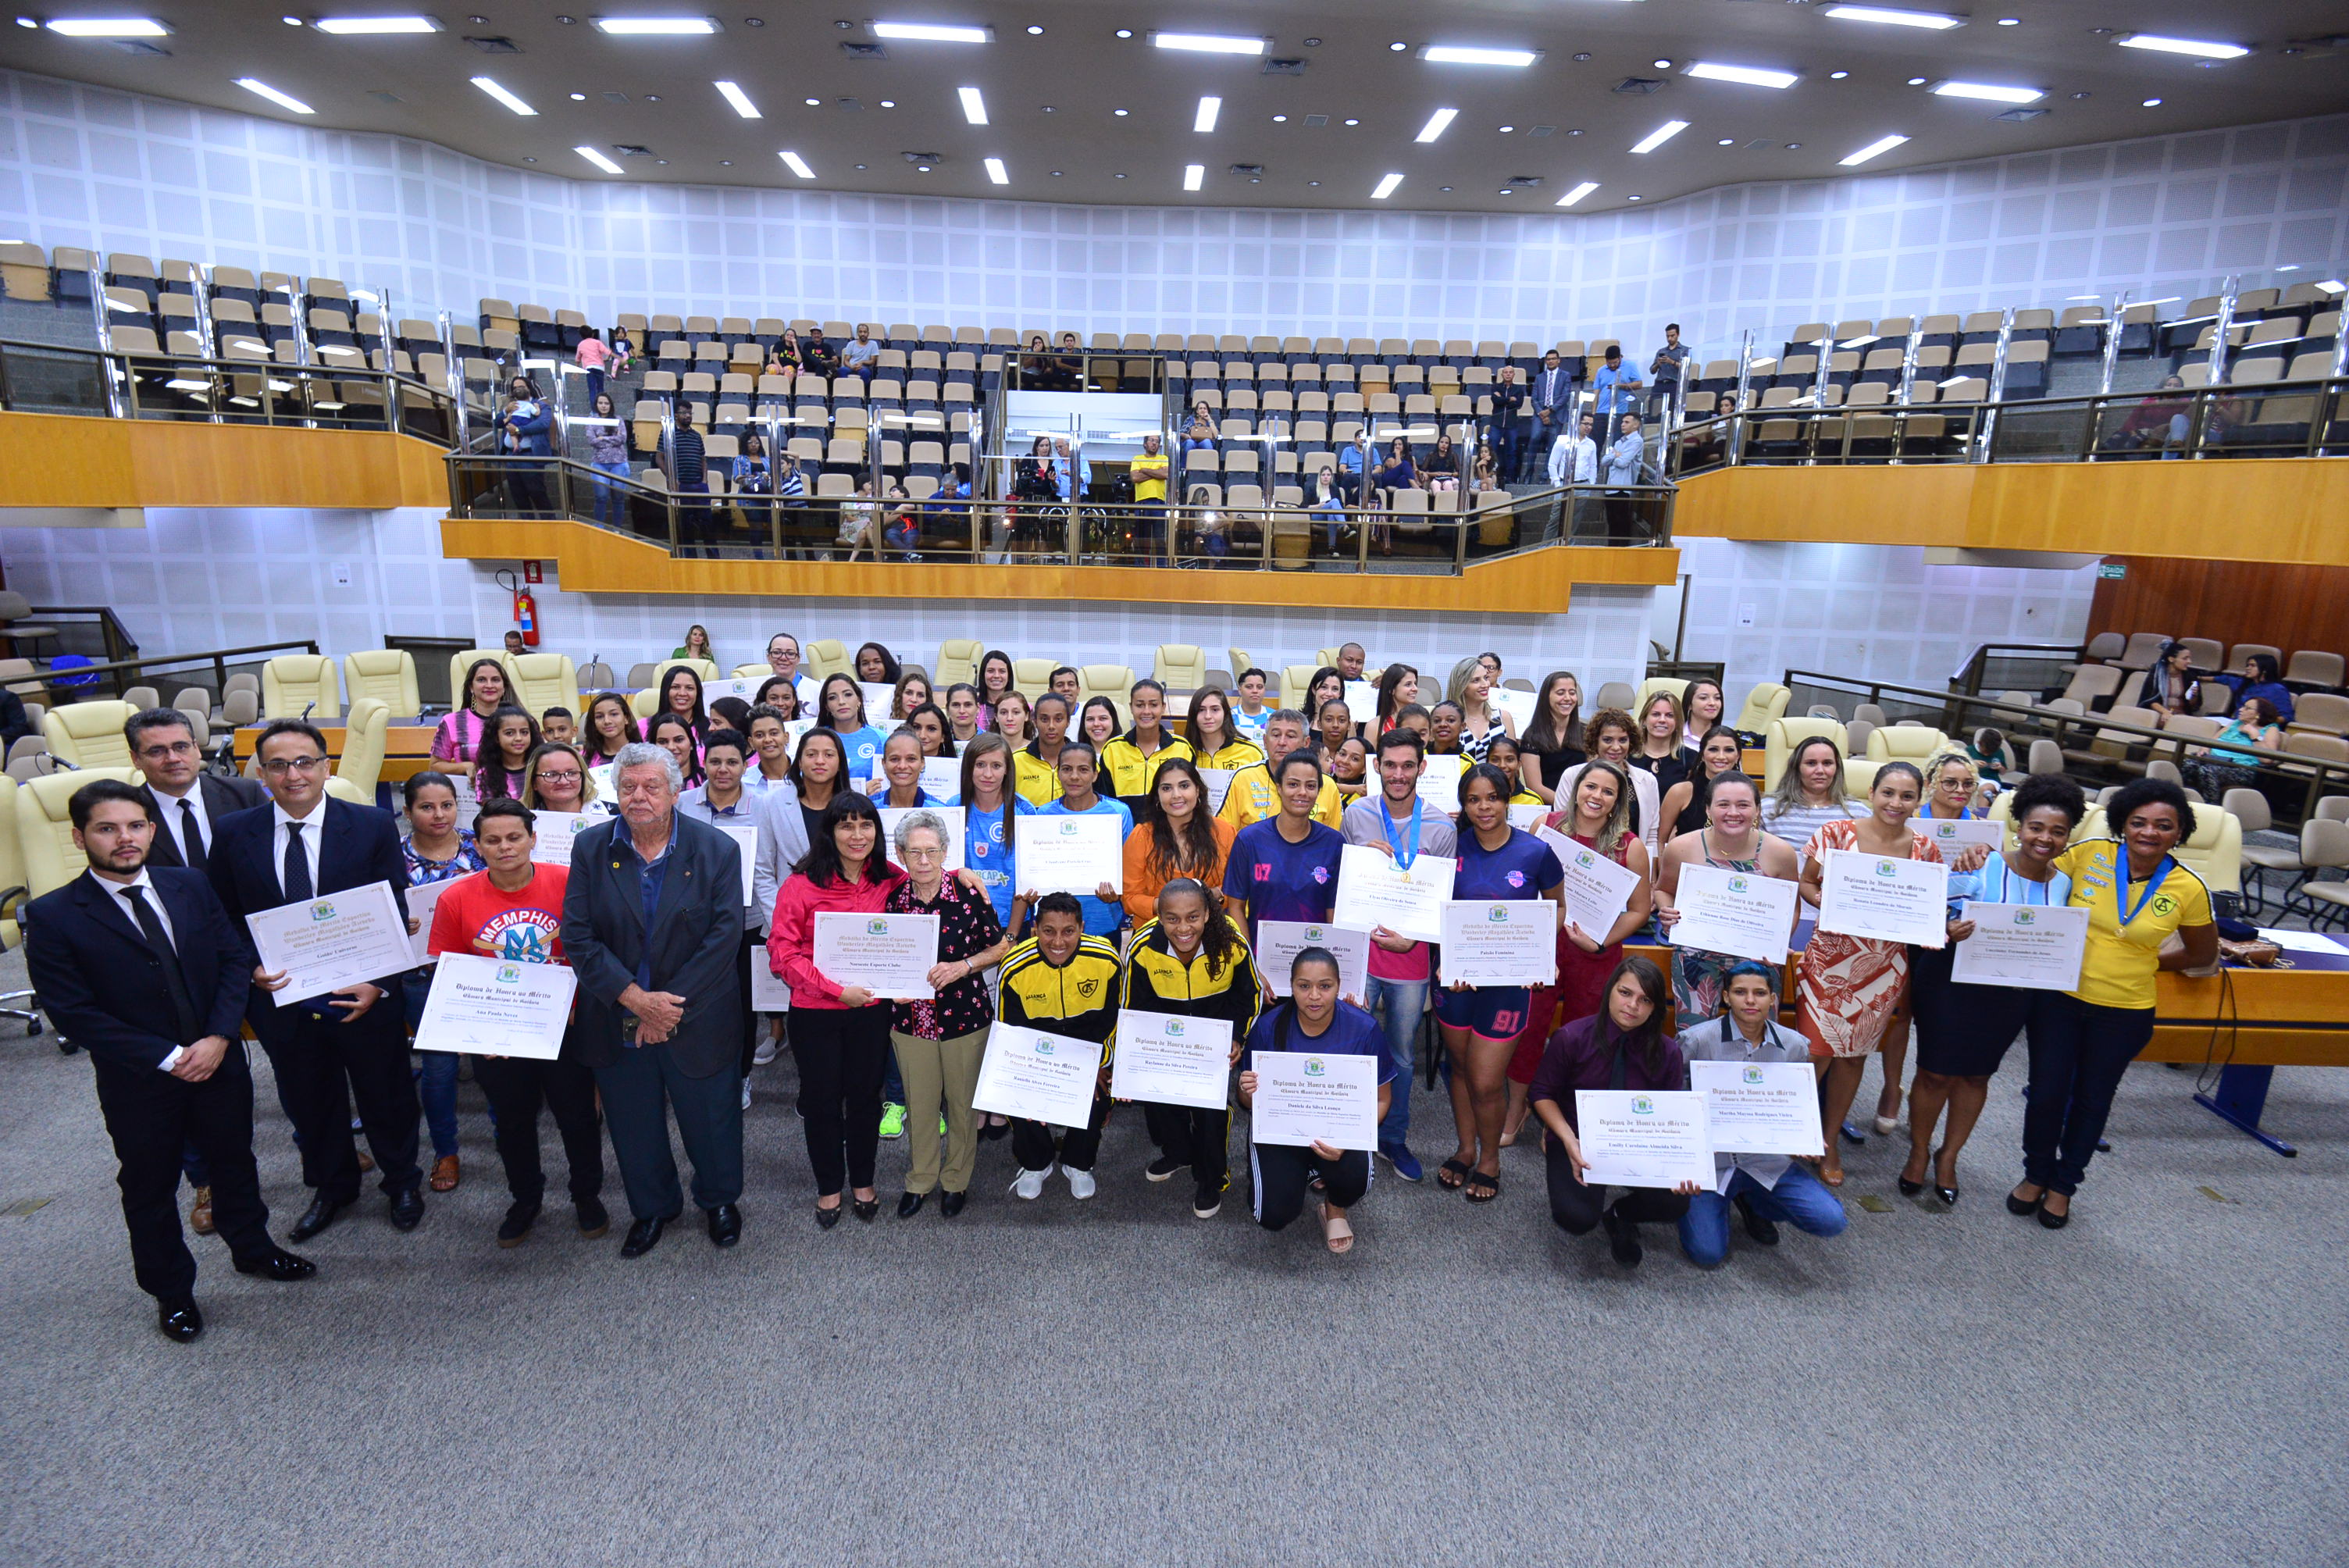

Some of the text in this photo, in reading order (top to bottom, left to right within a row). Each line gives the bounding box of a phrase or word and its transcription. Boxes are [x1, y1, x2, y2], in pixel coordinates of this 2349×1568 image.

[1254, 863, 1271, 882] 07
[479, 911, 558, 943] MEMPHIS
[454, 983, 484, 992] Diploma
[495, 987, 517, 996] Honra
[528, 991, 551, 1000] Mérito
[1025, 992, 1046, 1001] ALIANÇA
[1491, 1010, 1521, 1033] 91
